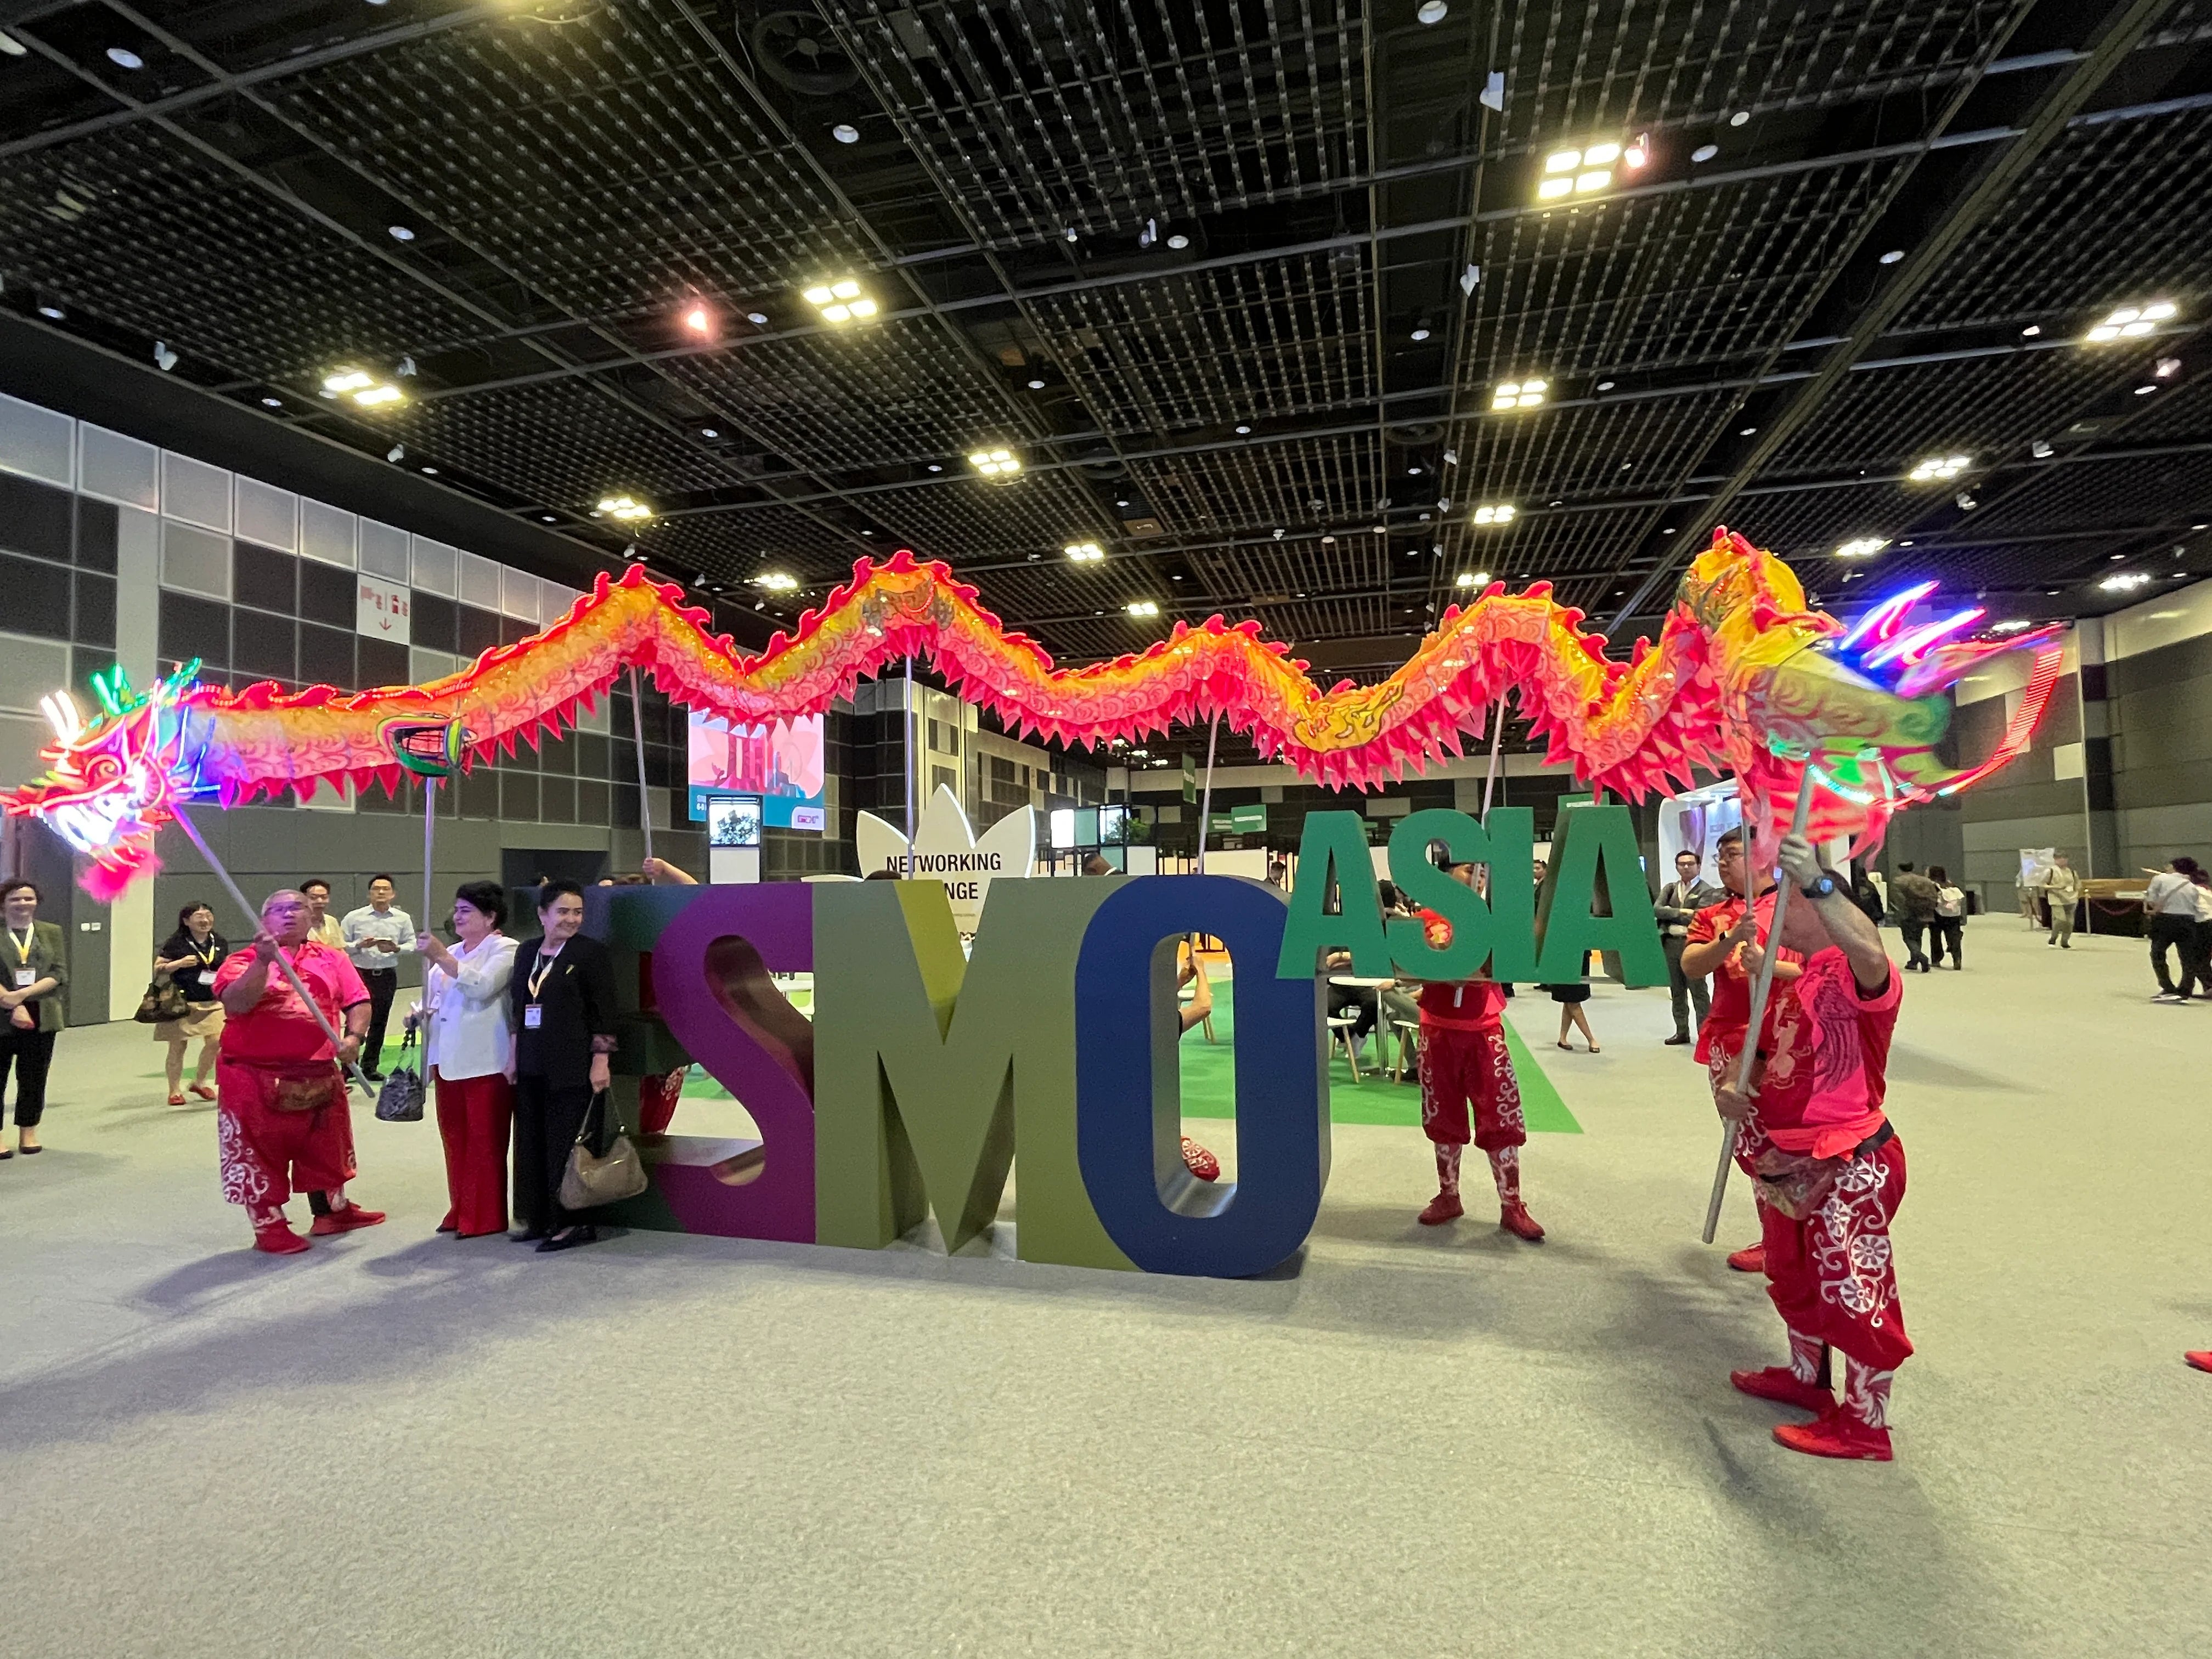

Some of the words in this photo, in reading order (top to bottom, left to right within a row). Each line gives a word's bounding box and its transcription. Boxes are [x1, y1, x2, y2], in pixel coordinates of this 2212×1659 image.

[887, 853, 1001, 872] NETWORKING
[944, 882, 979, 900] NGE
[1277, 806, 1671, 989] ASIA
